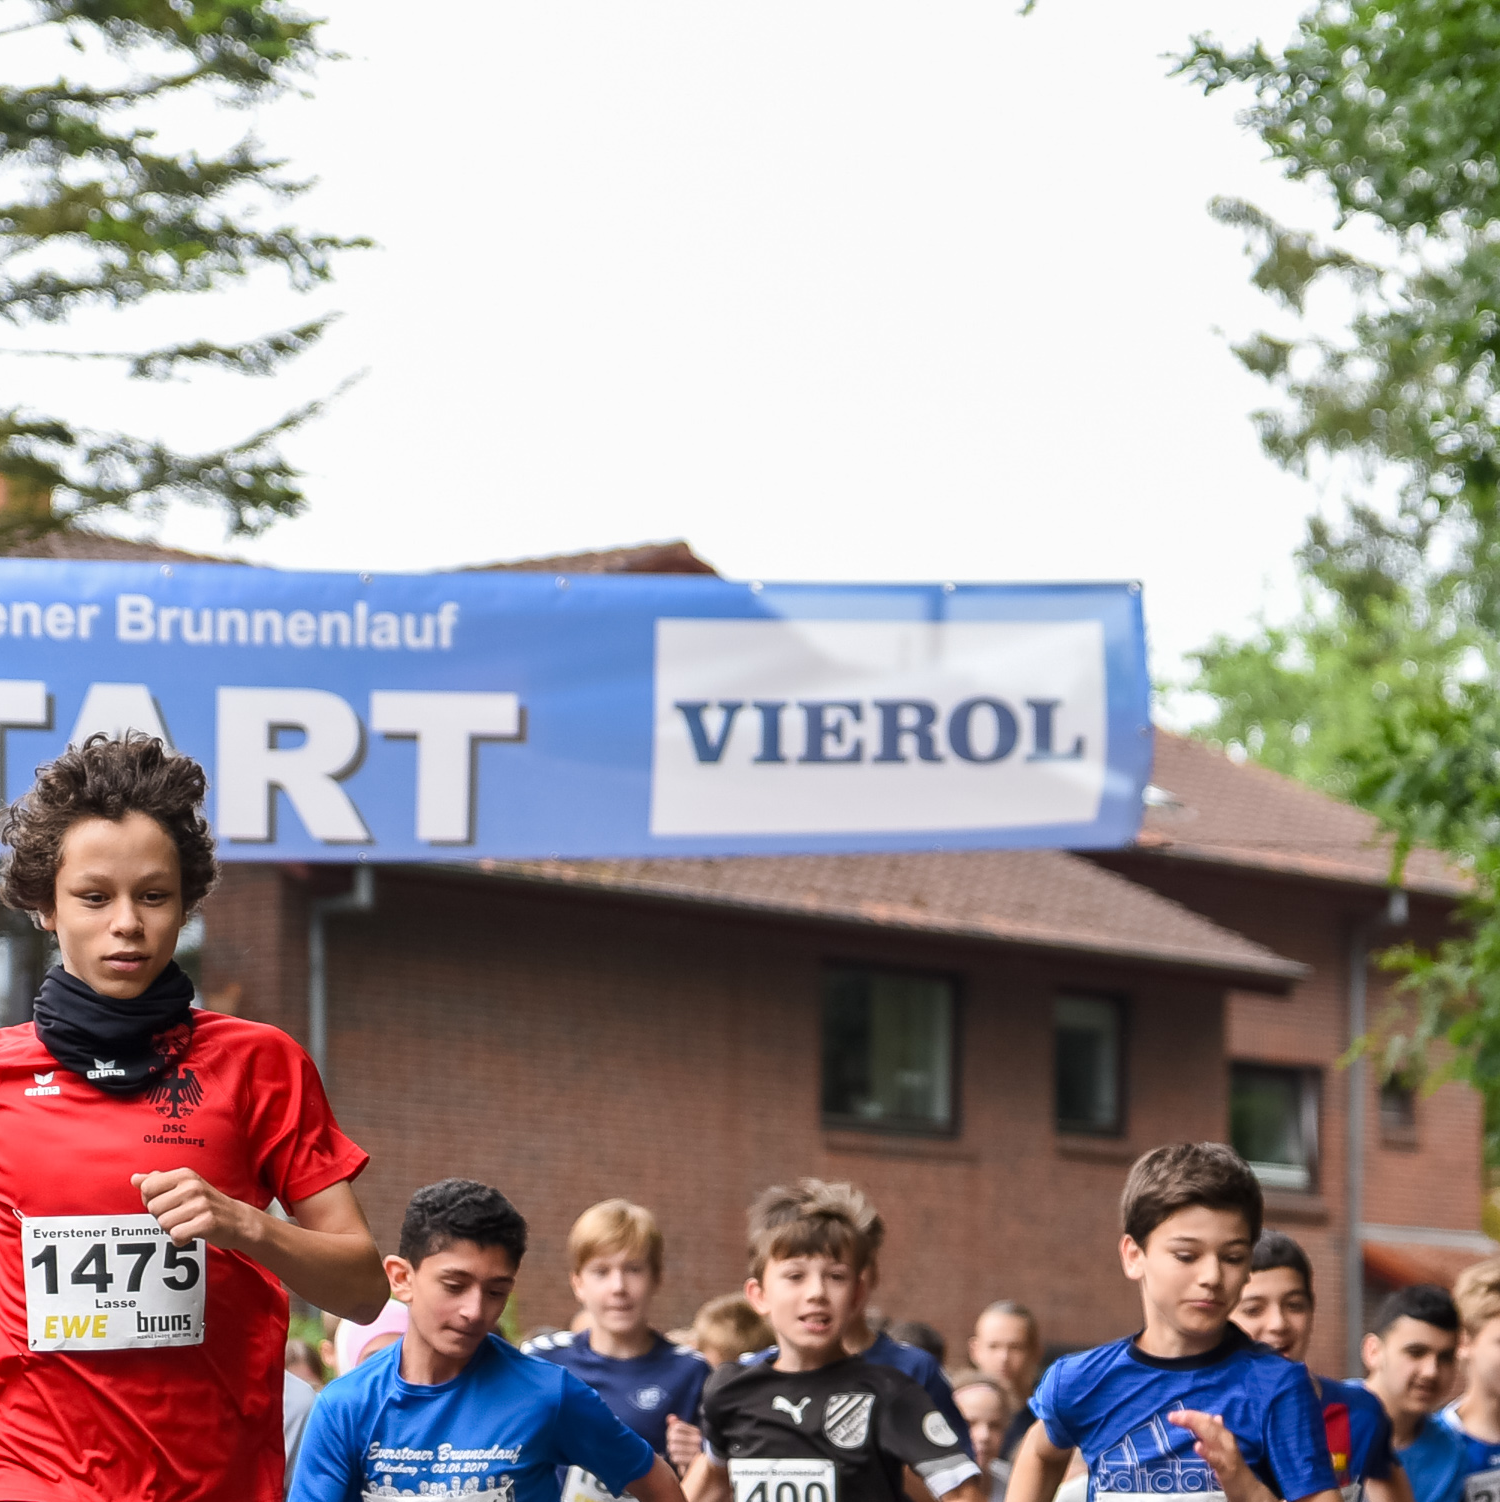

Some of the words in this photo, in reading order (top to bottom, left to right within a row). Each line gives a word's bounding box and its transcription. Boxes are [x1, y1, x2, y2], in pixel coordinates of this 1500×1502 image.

[115, 593, 460, 650] Brunnenlauf
[673, 695, 1086, 767] VIEROL
[86, 1068, 126, 1080] erima
[24, 1085, 61, 1097] erima
[162, 1124, 187, 1133] DSC
[143, 1135, 205, 1147] Oldenburg
[33, 1228, 107, 1239] Everstener
[31, 1240, 200, 1295] 1475
[95, 1299, 137, 1309] Lasse
[44, 1314, 108, 1339] EWE
[136, 1311, 192, 1333] bruns
[367, 1441, 435, 1461] Everstener
